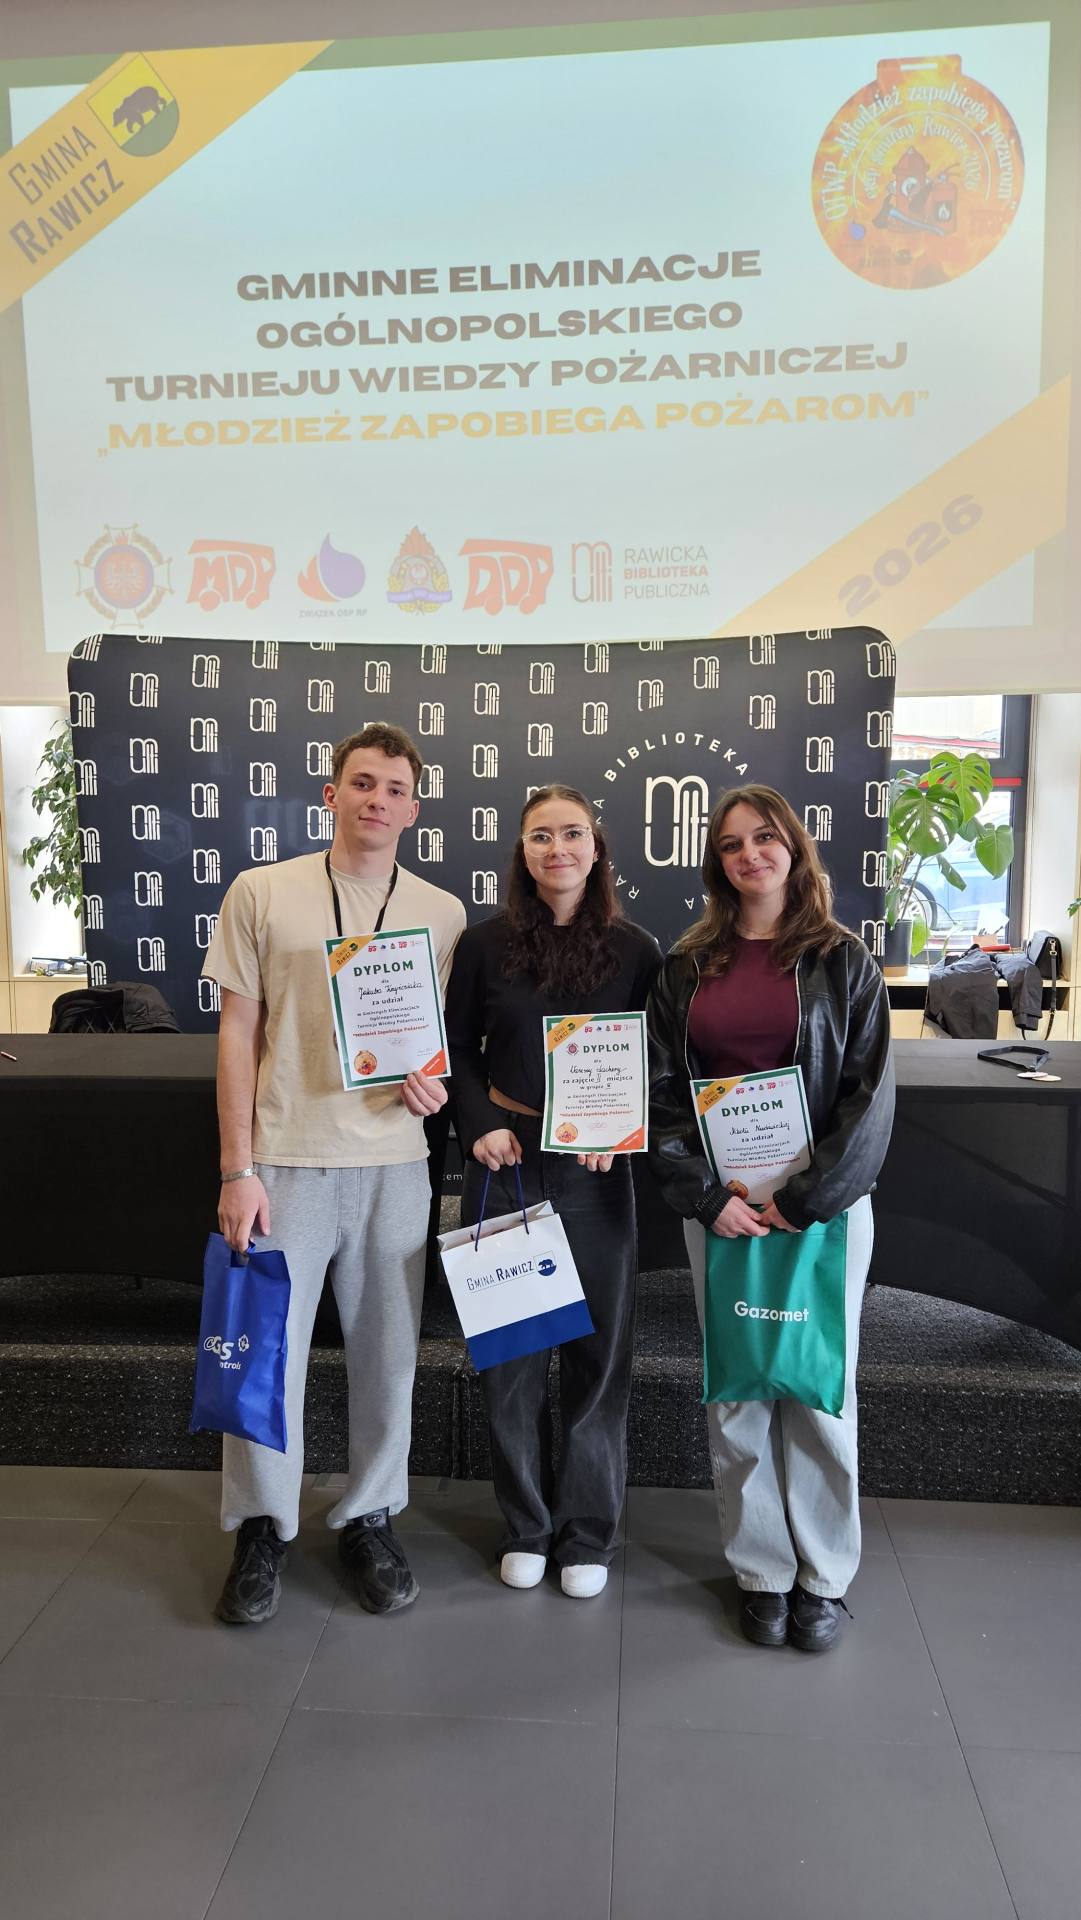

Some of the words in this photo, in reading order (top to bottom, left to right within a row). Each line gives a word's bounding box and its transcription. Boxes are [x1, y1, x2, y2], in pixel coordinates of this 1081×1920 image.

[8, 125, 96, 206] GMINA
[9, 159, 125, 265] RAWICZ
[236, 268, 440, 301] GMINNE
[449, 249, 762, 293] ELIMINACJE
[256, 301, 743, 349] OGÓLNOPOLSKIEGO
[106, 369, 340, 403] TURNIEJU
[348, 361, 541, 393] WIEDZY
[551, 342, 908, 388] POŻARNICZEJ
[97, 410, 352, 458] „MŁODZIEŻ
[360, 403, 646, 442] ZAPOBIEGA
[656, 390, 930, 430] POŻAROM”
[623, 545, 708, 566] RAWICKA
[838, 494, 984, 619] 2026
[623, 565, 709, 580] BIBLIOTEKA
[623, 582, 710, 600] PUBLICZNA
[604, 732, 748, 782] BIBLIOTEKA
[353, 960, 414, 977] DYPLOM
[382, 996, 404, 1005] udział
[583, 1043, 630, 1054] DYPLOM
[571, 1077, 594, 1085] zajęcie
[721, 1099, 784, 1117] DYPLOM
[751, 1134, 774, 1142] udział
[467, 1274, 495, 1291] GMINA
[496, 1260, 534, 1281] RAWICZ
[734, 1301, 809, 1322] Gazomet
